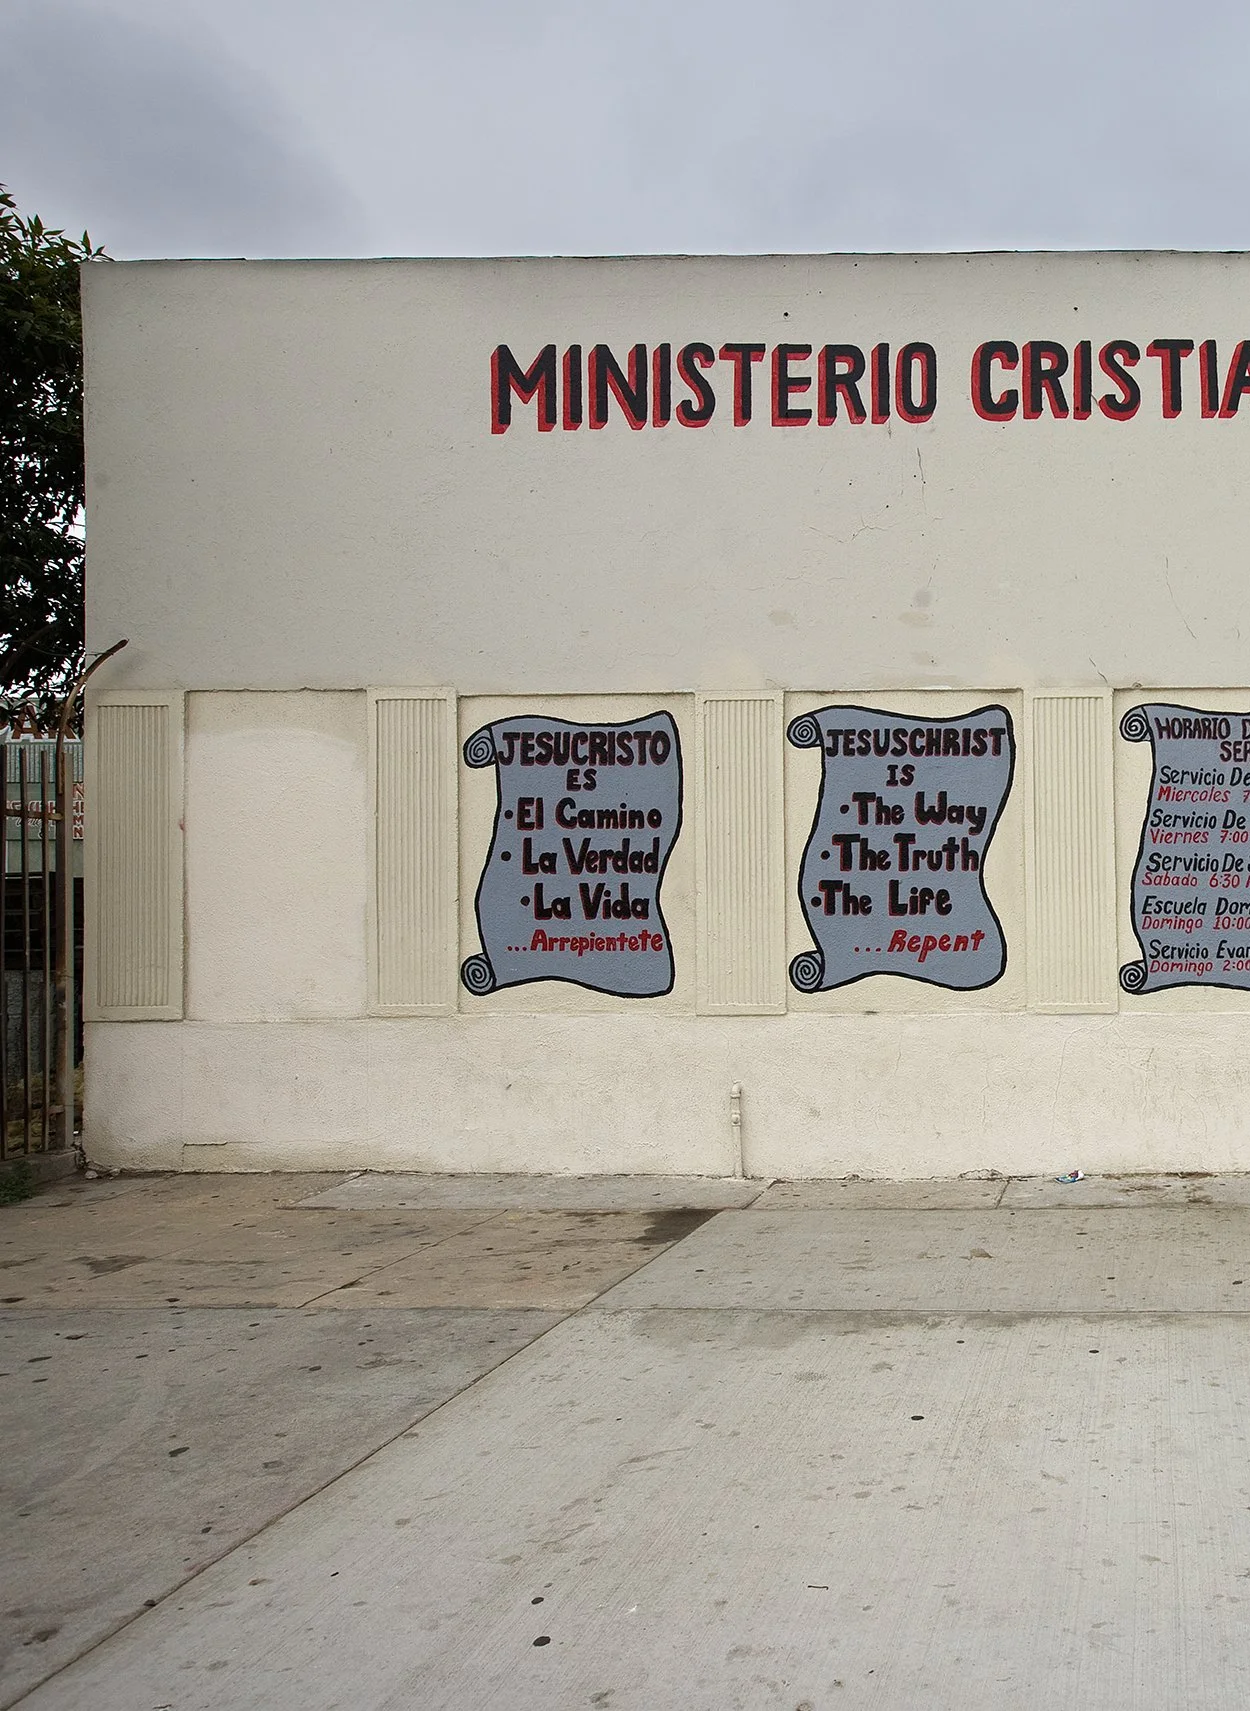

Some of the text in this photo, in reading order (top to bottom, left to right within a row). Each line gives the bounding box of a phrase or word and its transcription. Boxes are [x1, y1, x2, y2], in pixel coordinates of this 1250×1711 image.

[490, 342, 937, 434] MINISTERIO
[1154, 717, 1231, 740] HORARIO
[498, 730, 671, 766] JESUCRISTO
[566, 768, 597, 792] ES
[886, 764, 915, 787] IS
[1159, 765, 1225, 787] Servicio
[1157, 785, 1231, 803] Miercoles
[517, 797, 662, 831] El Camino
[852, 791, 987, 835] The Way
[1150, 808, 1217, 830] Servicio
[1222, 809, 1247, 830] De
[1150, 829, 1208, 844] Viernes
[1220, 830, 1248, 844] 7:00
[522, 836, 660, 875] La Verdad
[832, 833, 980, 872] The Truth
[1145, 852, 1219, 873] Servicio
[1222, 853, 1244, 873] De
[1141, 871, 1198, 886] Sabado
[1209, 873, 1241, 888] 6:30
[534, 882, 650, 920] La Vida
[818, 879, 952, 917] The Life
[1141, 895, 1207, 915] Escuela
[1141, 916, 1203, 934] Domingo
[1149, 939, 1208, 960] Servicio
[1150, 959, 1213, 976] Domingo
